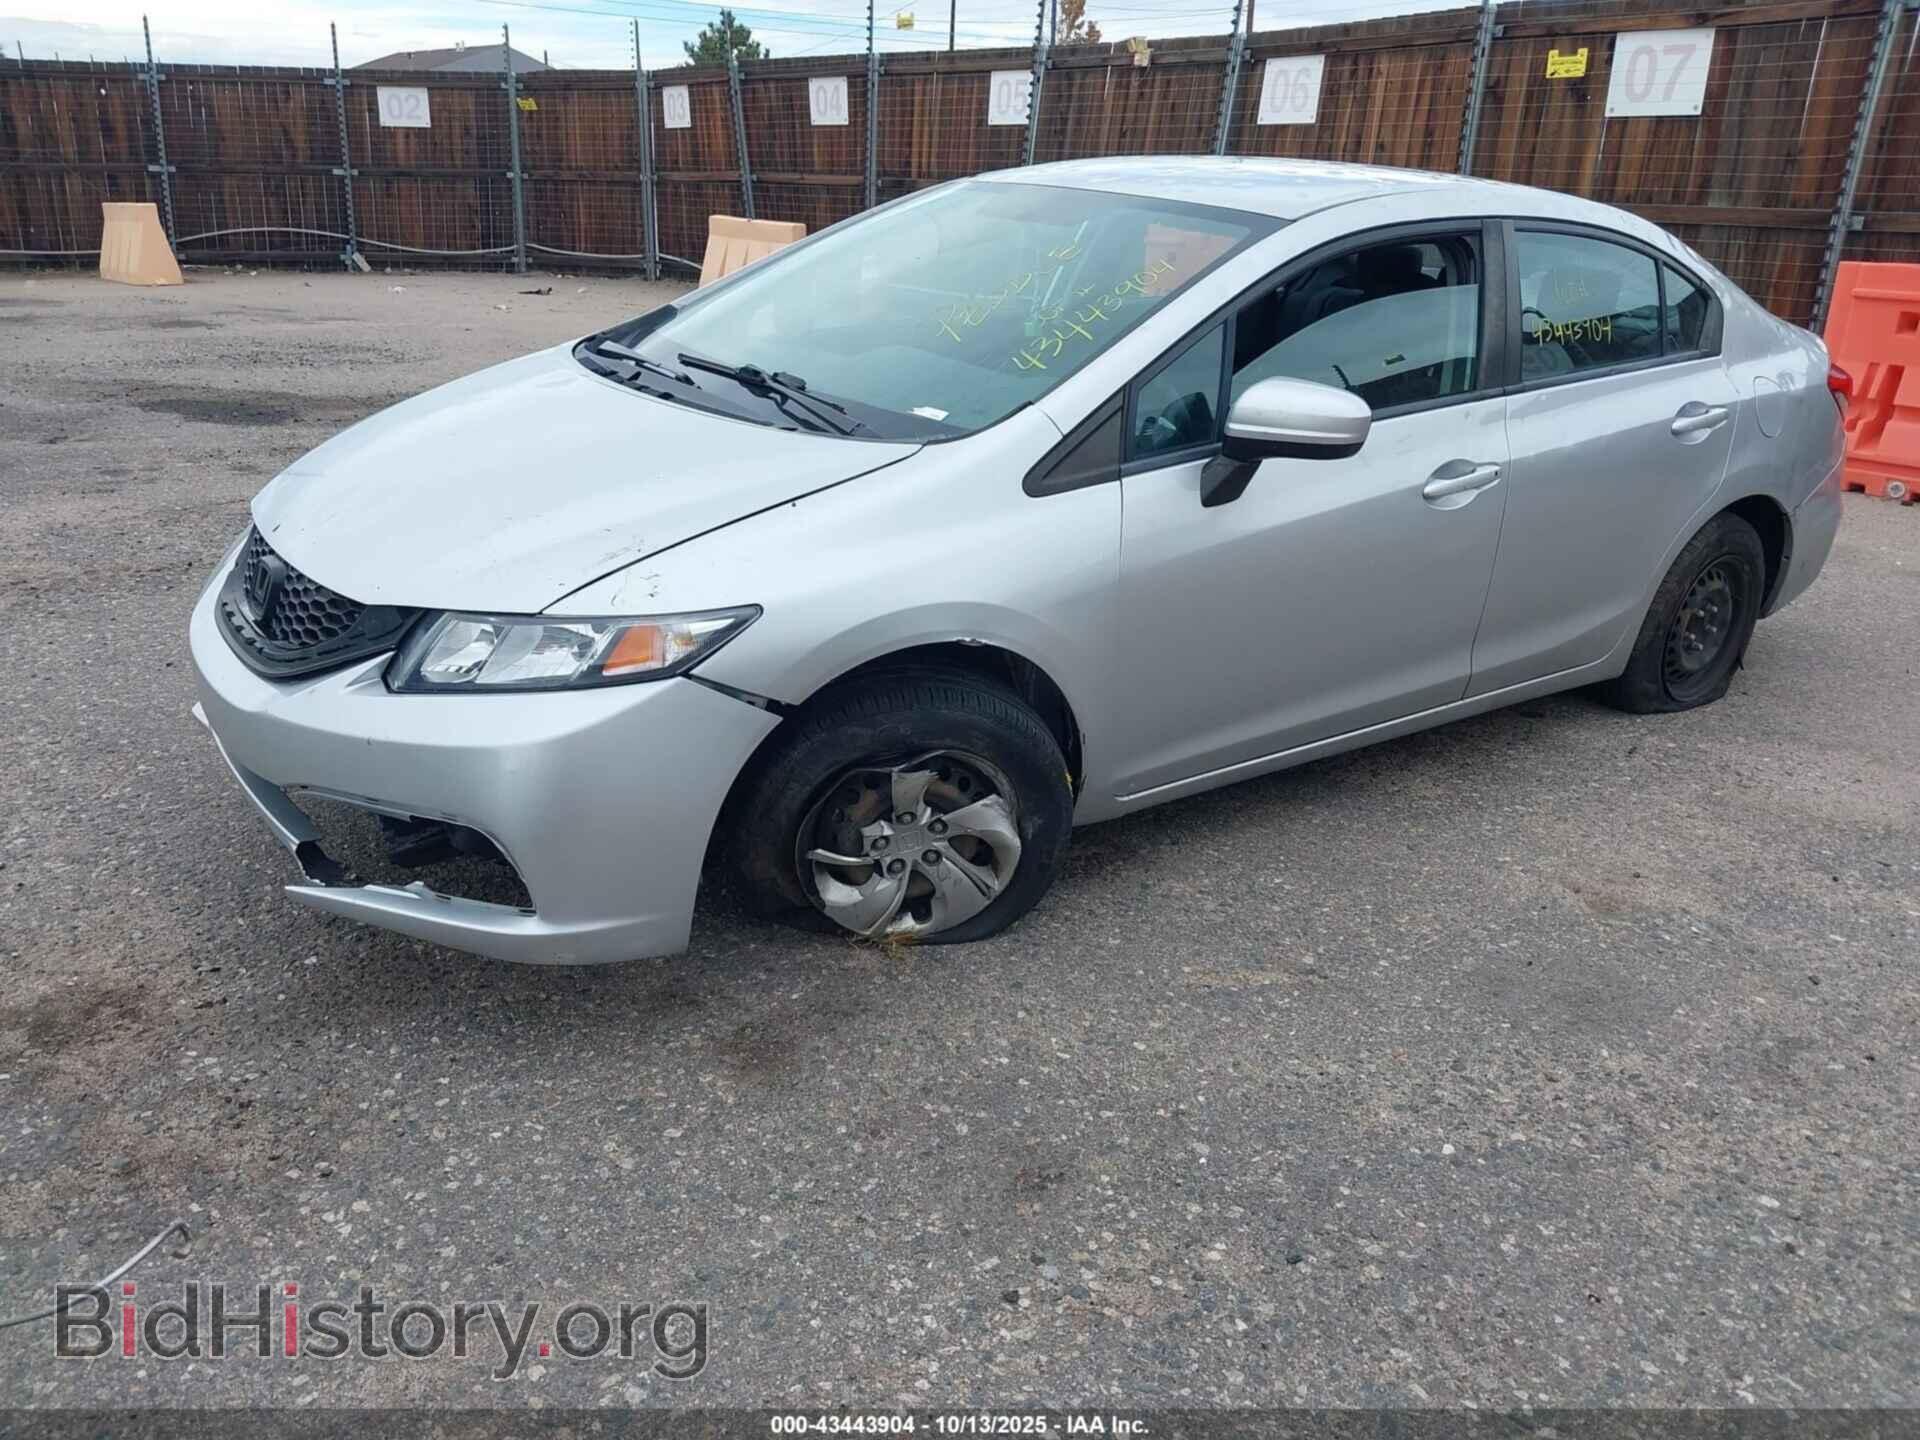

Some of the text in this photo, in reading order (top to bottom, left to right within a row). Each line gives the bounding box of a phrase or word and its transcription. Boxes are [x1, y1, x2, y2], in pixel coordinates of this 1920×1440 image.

[1269, 67, 1311, 112] 06
[1624, 44, 1696, 103] 07
[386, 93, 421, 119] 02
[667, 93, 687, 121] 03
[815, 84, 843, 117] 04
[999, 79, 1027, 114] 05
[1011, 258, 1175, 371] 43443904
